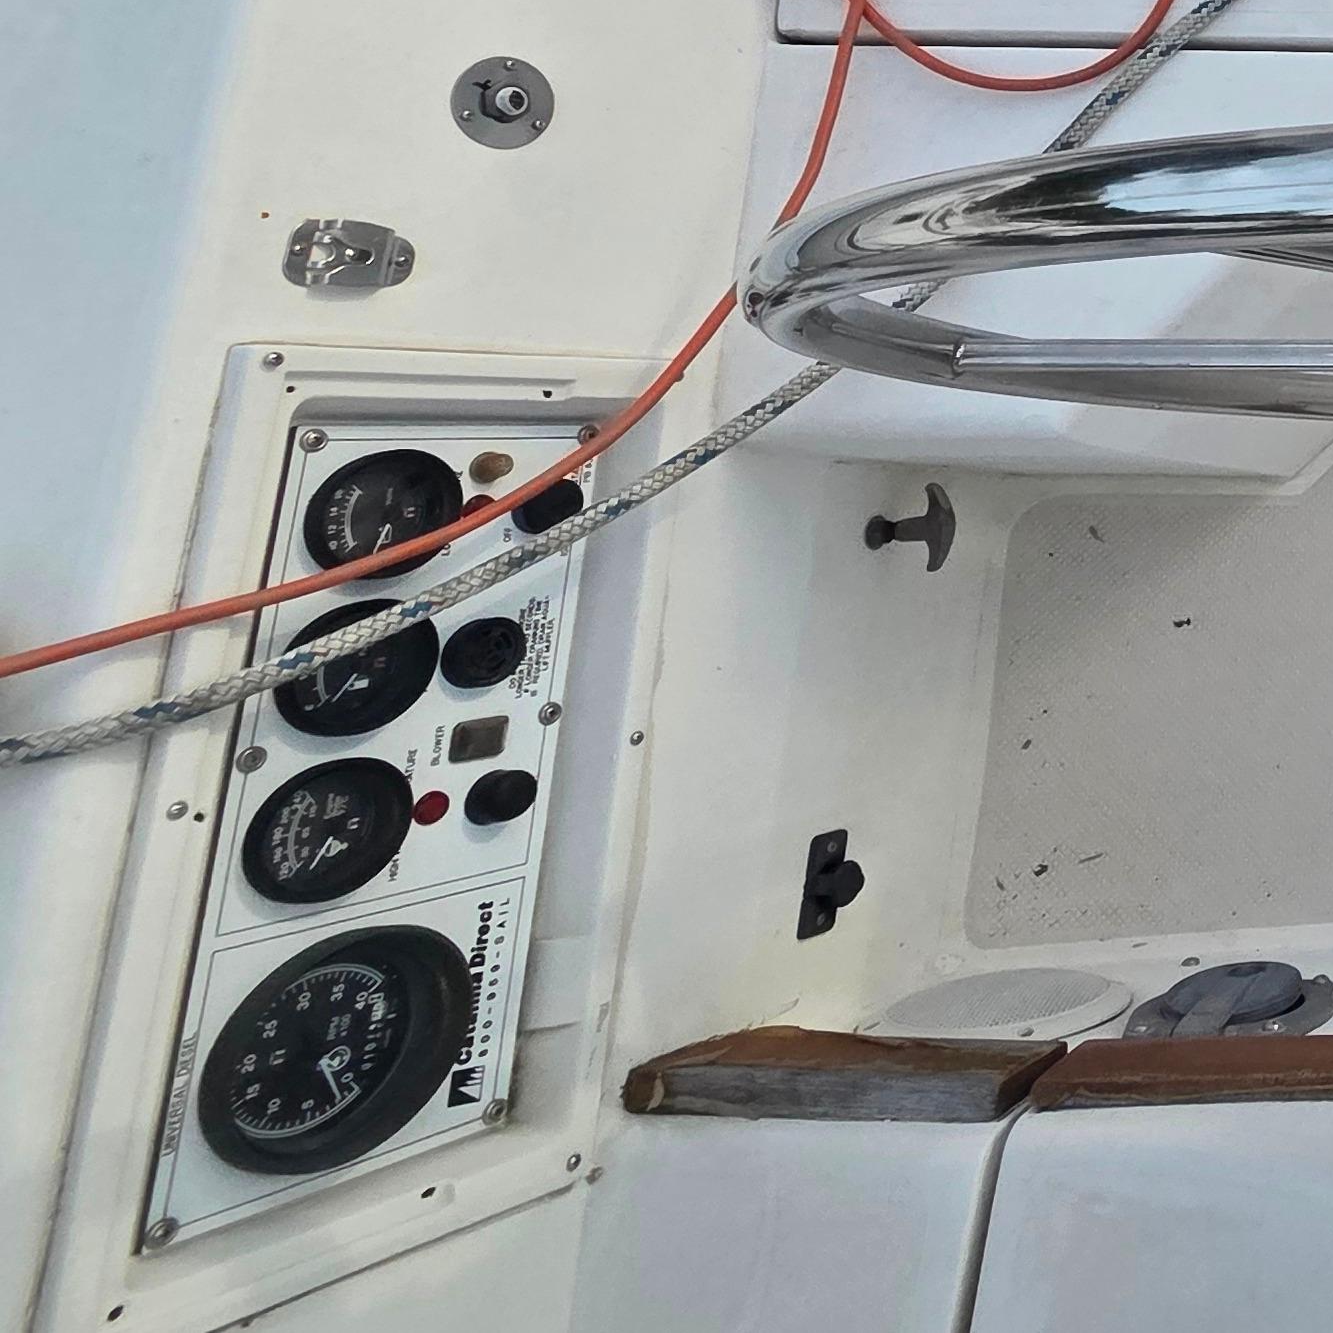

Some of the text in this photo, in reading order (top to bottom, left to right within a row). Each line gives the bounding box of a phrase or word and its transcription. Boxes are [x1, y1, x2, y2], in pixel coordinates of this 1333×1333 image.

[502, 527, 512, 543] OFF
[430, 724, 446, 767] BLOWER
[469, 901, 494, 968] Direct
[296, 991, 312, 1011] 30
[331, 983, 346, 1002] 35
[354, 991, 369, 1010] 40
[262, 1019, 279, 1039] 25
[240, 1053, 257, 1074] 20
[341, 1072, 354, 1084] 0
[245, 1083, 261, 1100] 15
[267, 1097, 282, 1115] 10
[301, 1098, 315, 1110] 5
[159, 1081, 187, 1158] UNIVERSAL
